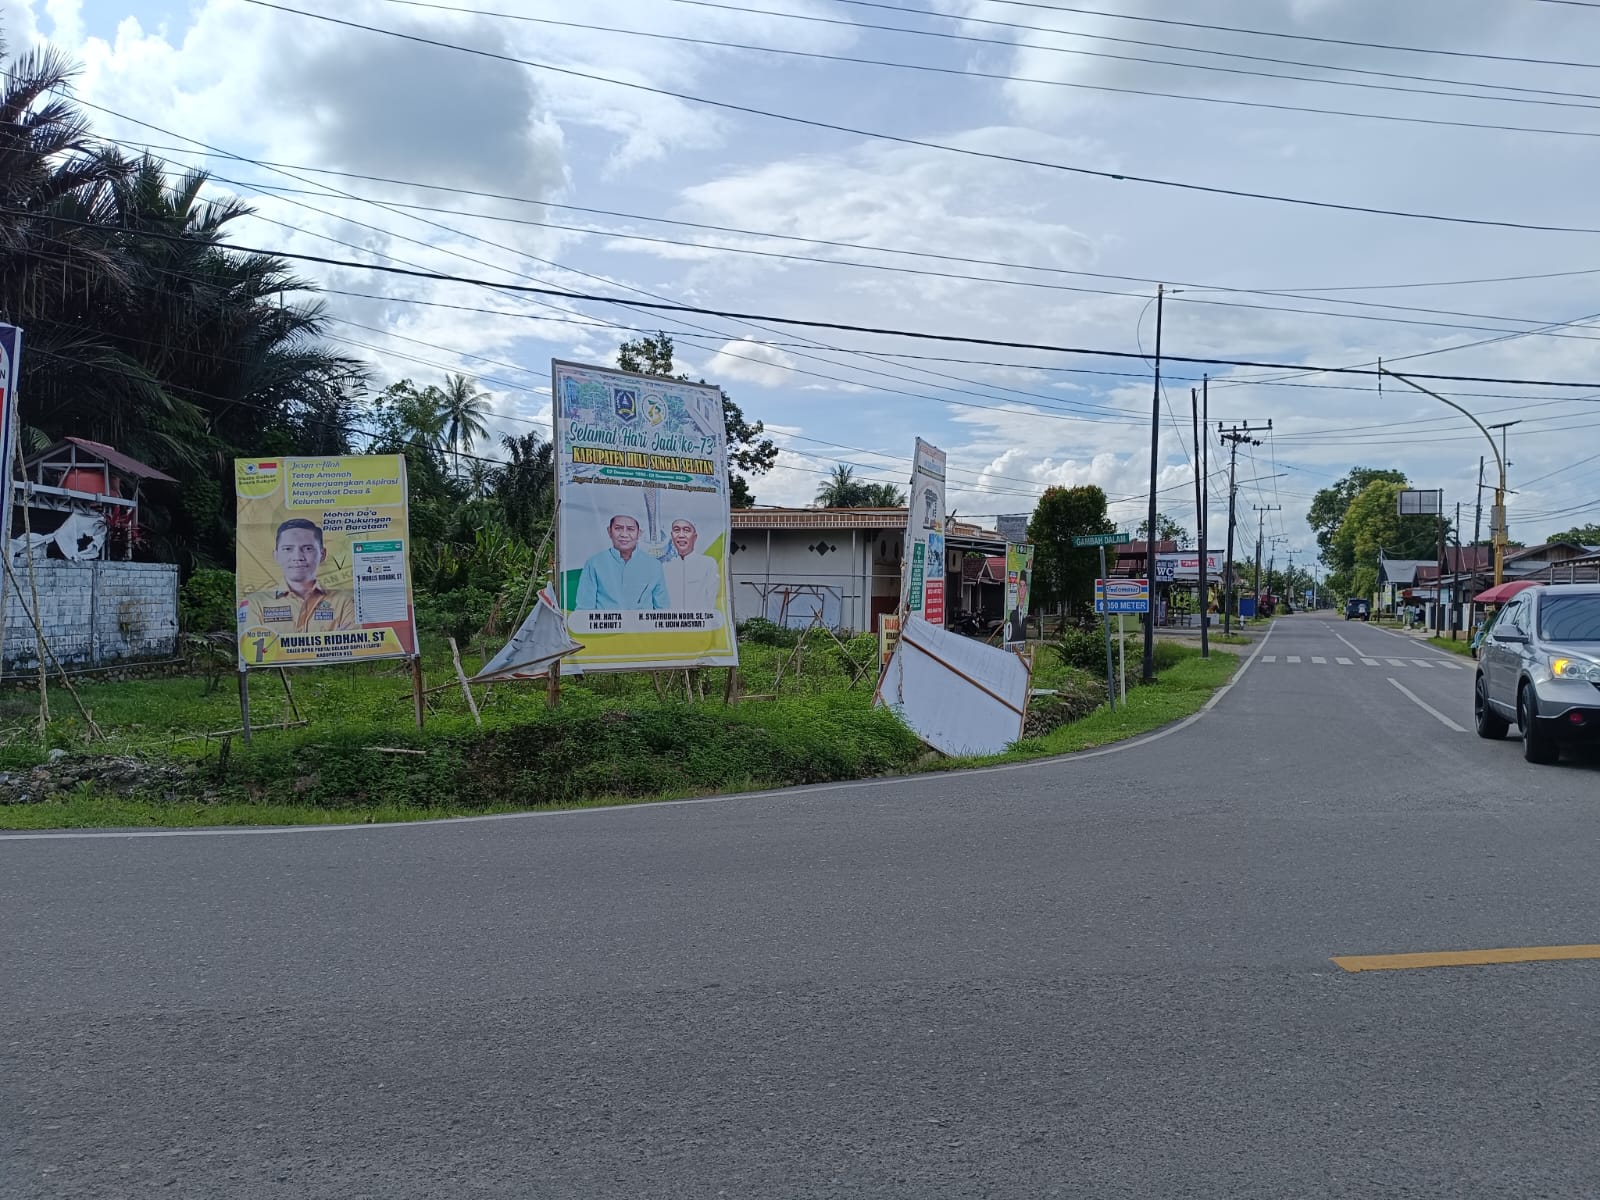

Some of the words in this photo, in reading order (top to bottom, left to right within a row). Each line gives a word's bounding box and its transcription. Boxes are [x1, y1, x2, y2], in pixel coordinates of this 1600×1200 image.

[569, 422, 617, 445] Selamat
[621, 427, 648, 448] Hari
[651, 432, 678, 452] Jadi
[572, 446, 625, 467] KABUPATEN
[626, 451, 649, 469] HULU
[650, 454, 681, 472] SUNGAI
[681, 458, 714, 475] SELATAN
[292, 472, 314, 481] Tetap
[316, 471, 351, 479] Amanah
[292, 479, 364, 489] Memperjuangkan
[365, 478, 399, 486] Aspirasi
[292, 488, 341, 497] Masyarakat
[344, 516, 391, 526] Dukungan
[322, 524, 343, 532] Pian
[345, 522, 388, 531] Barataan
[1076, 536, 1103, 546] GAMBAH
[1104, 535, 1126, 544] DALAM
[367, 565, 372, 573] 4
[1157, 567, 1174, 576] WC
[1120, 601, 1146, 609] METER
[645, 612, 678, 620] SYAFRUDIN
[280, 634, 322, 648] MUHLIS
[372, 631, 385, 642] ST
[252, 638, 264, 663] 1
